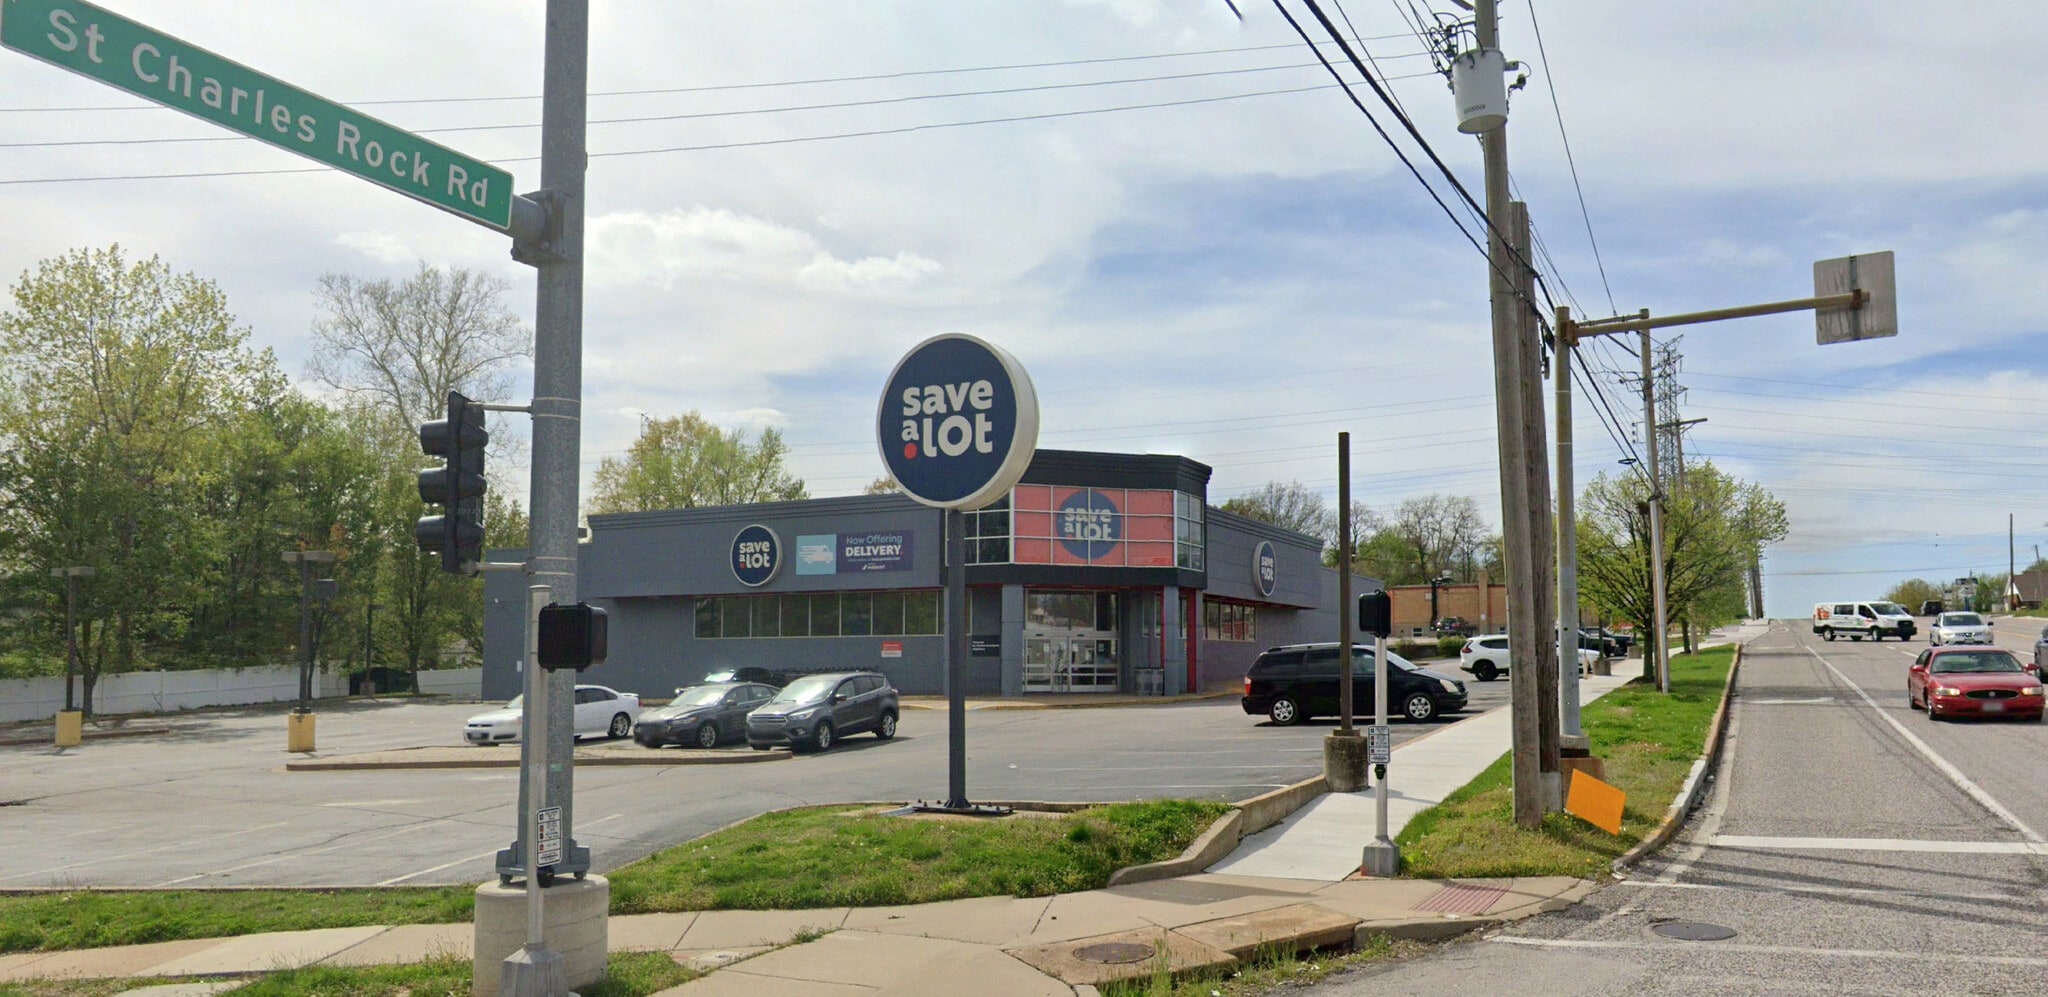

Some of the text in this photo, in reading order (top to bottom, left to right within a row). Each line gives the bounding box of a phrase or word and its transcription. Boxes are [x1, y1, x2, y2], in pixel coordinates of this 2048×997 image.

[47, 8, 489, 208] St Charles Rock Rd
[903, 379, 994, 416] save
[901, 419, 919, 441] a
[1064, 507, 1112, 523] save
[739, 541, 770, 553] save
[846, 534, 903, 545] Now Offering
